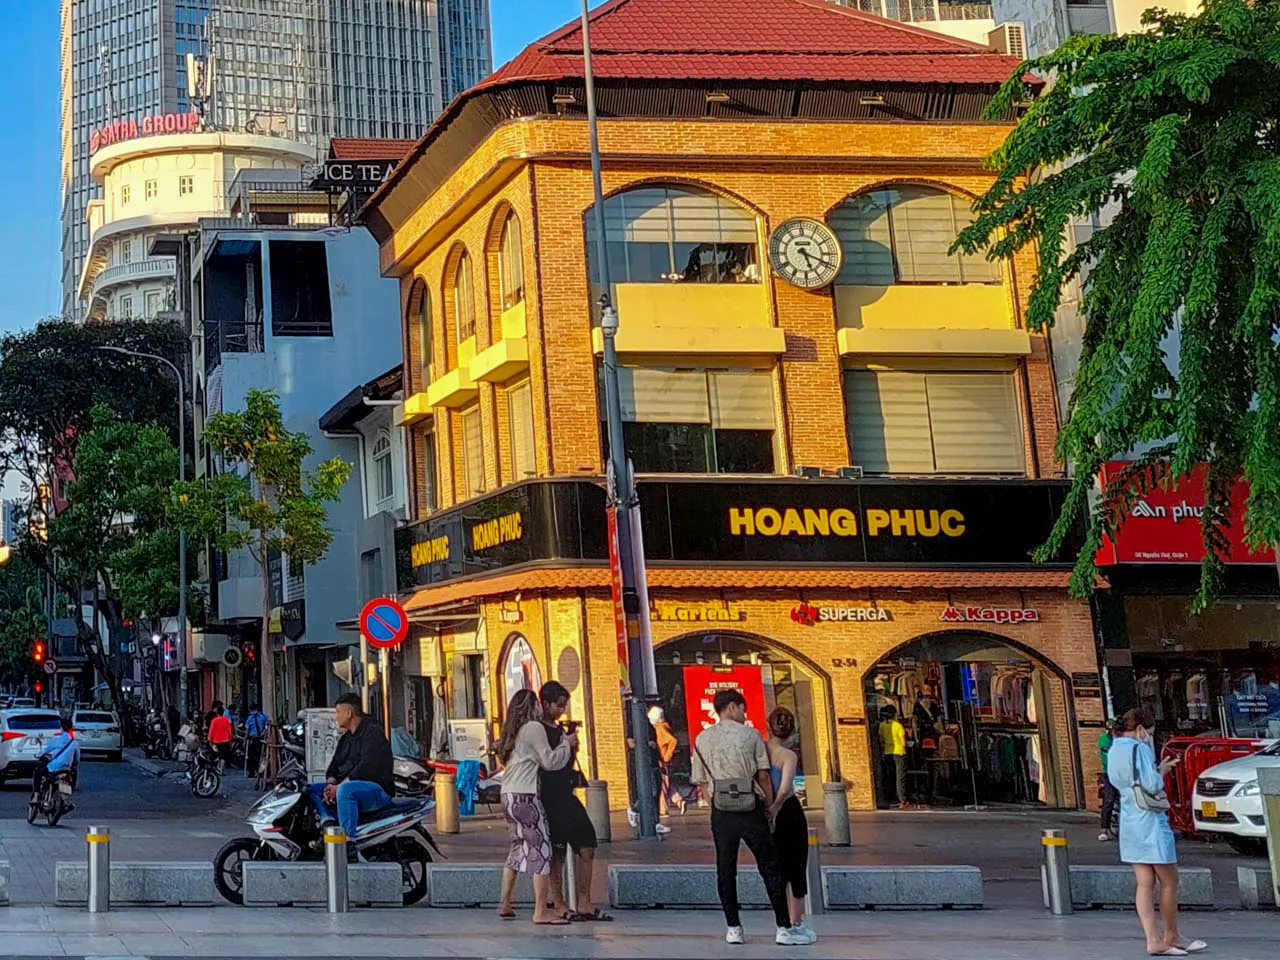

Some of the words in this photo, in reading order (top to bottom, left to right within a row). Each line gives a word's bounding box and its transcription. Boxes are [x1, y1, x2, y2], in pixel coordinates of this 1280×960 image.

[101, 119, 138, 144] SATRA
[143, 113, 199, 134] GROUP
[473, 519, 499, 551] HOANG
[499, 512, 522, 543] PHUC
[730, 508, 857, 536] HOANG
[867, 509, 966, 537] PHUC
[411, 540, 431, 568] HOANG
[431, 535, 449, 561] PHUC
[661, 605, 740, 620] Martens
[819, 607, 888, 621] SUPERGA
[967, 607, 1039, 624] Kappa
